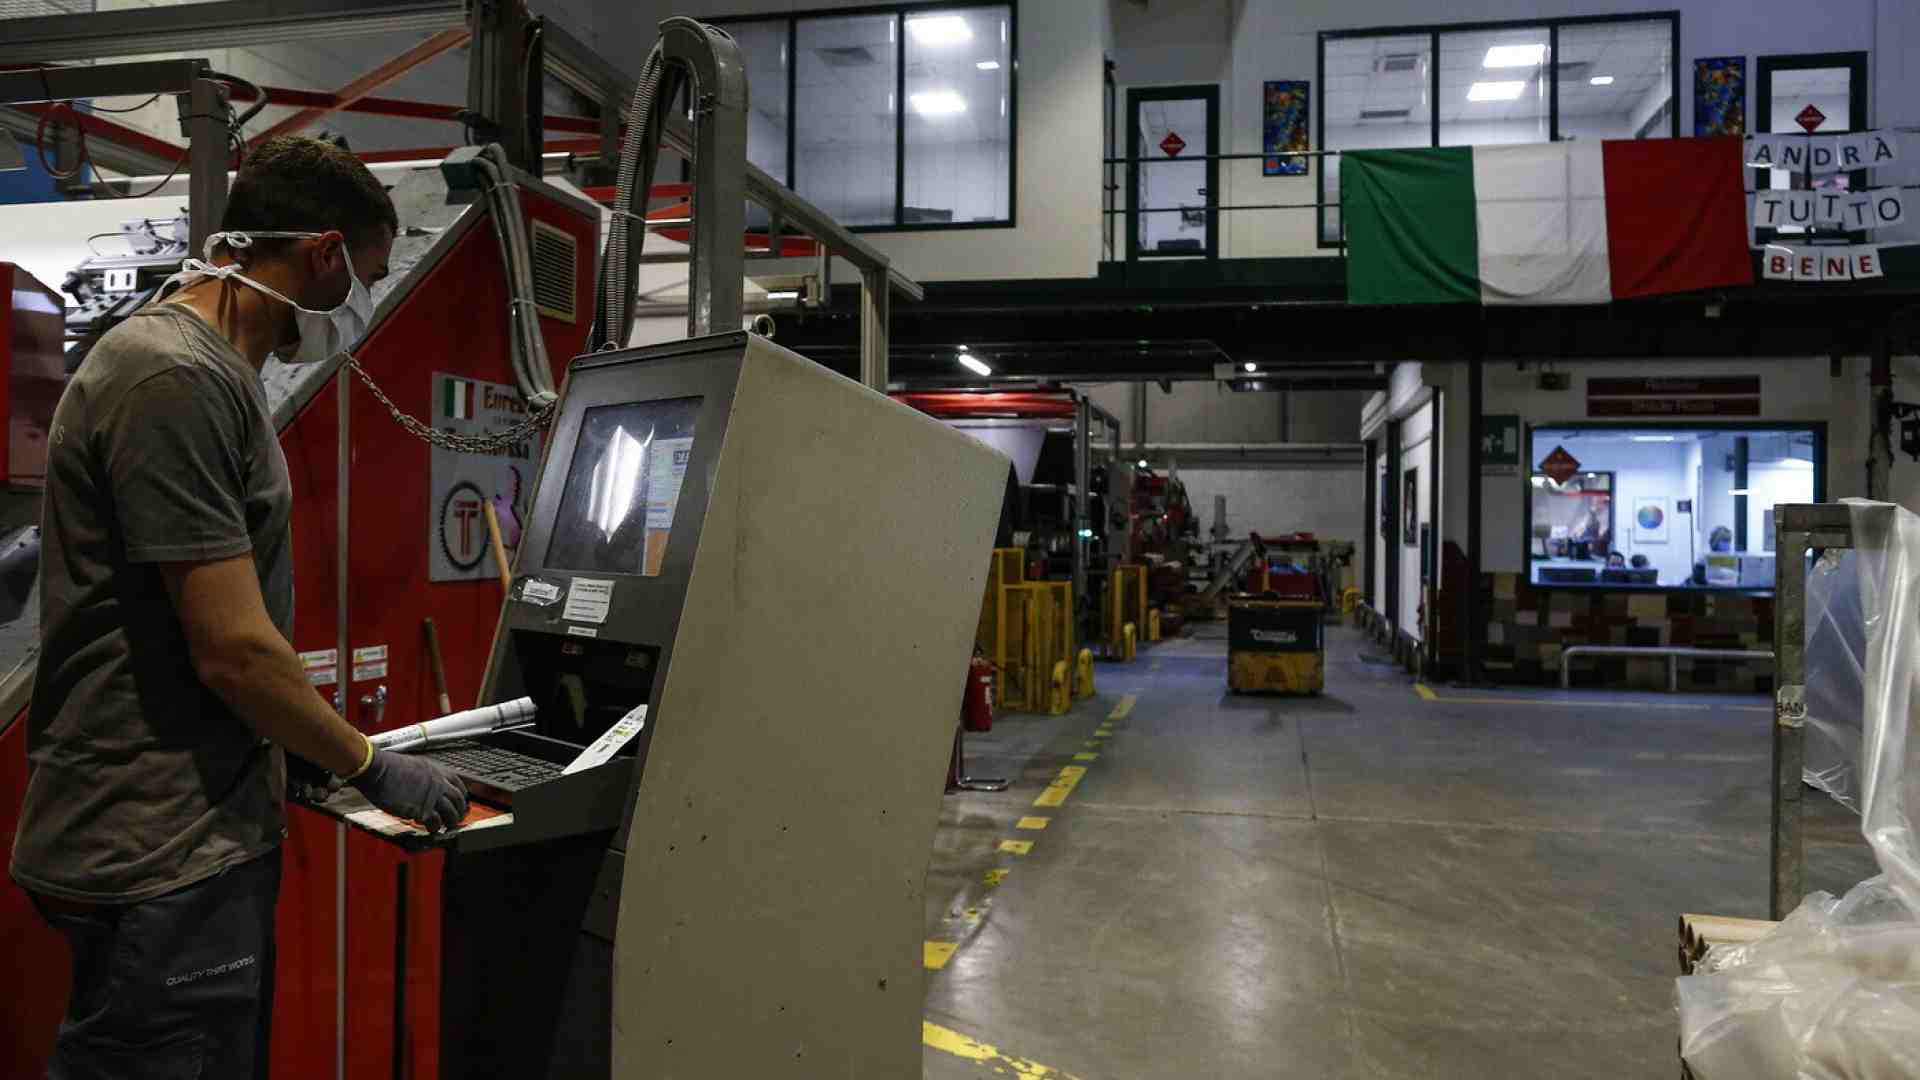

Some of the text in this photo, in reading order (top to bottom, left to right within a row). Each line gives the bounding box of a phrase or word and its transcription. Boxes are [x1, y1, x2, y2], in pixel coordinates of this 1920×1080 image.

[1754, 137, 1893, 166] ANDRÀ
[1763, 195, 1901, 225] TUTTO
[1770, 255, 1873, 276] BENE
[166, 969, 204, 987] QUALITY
